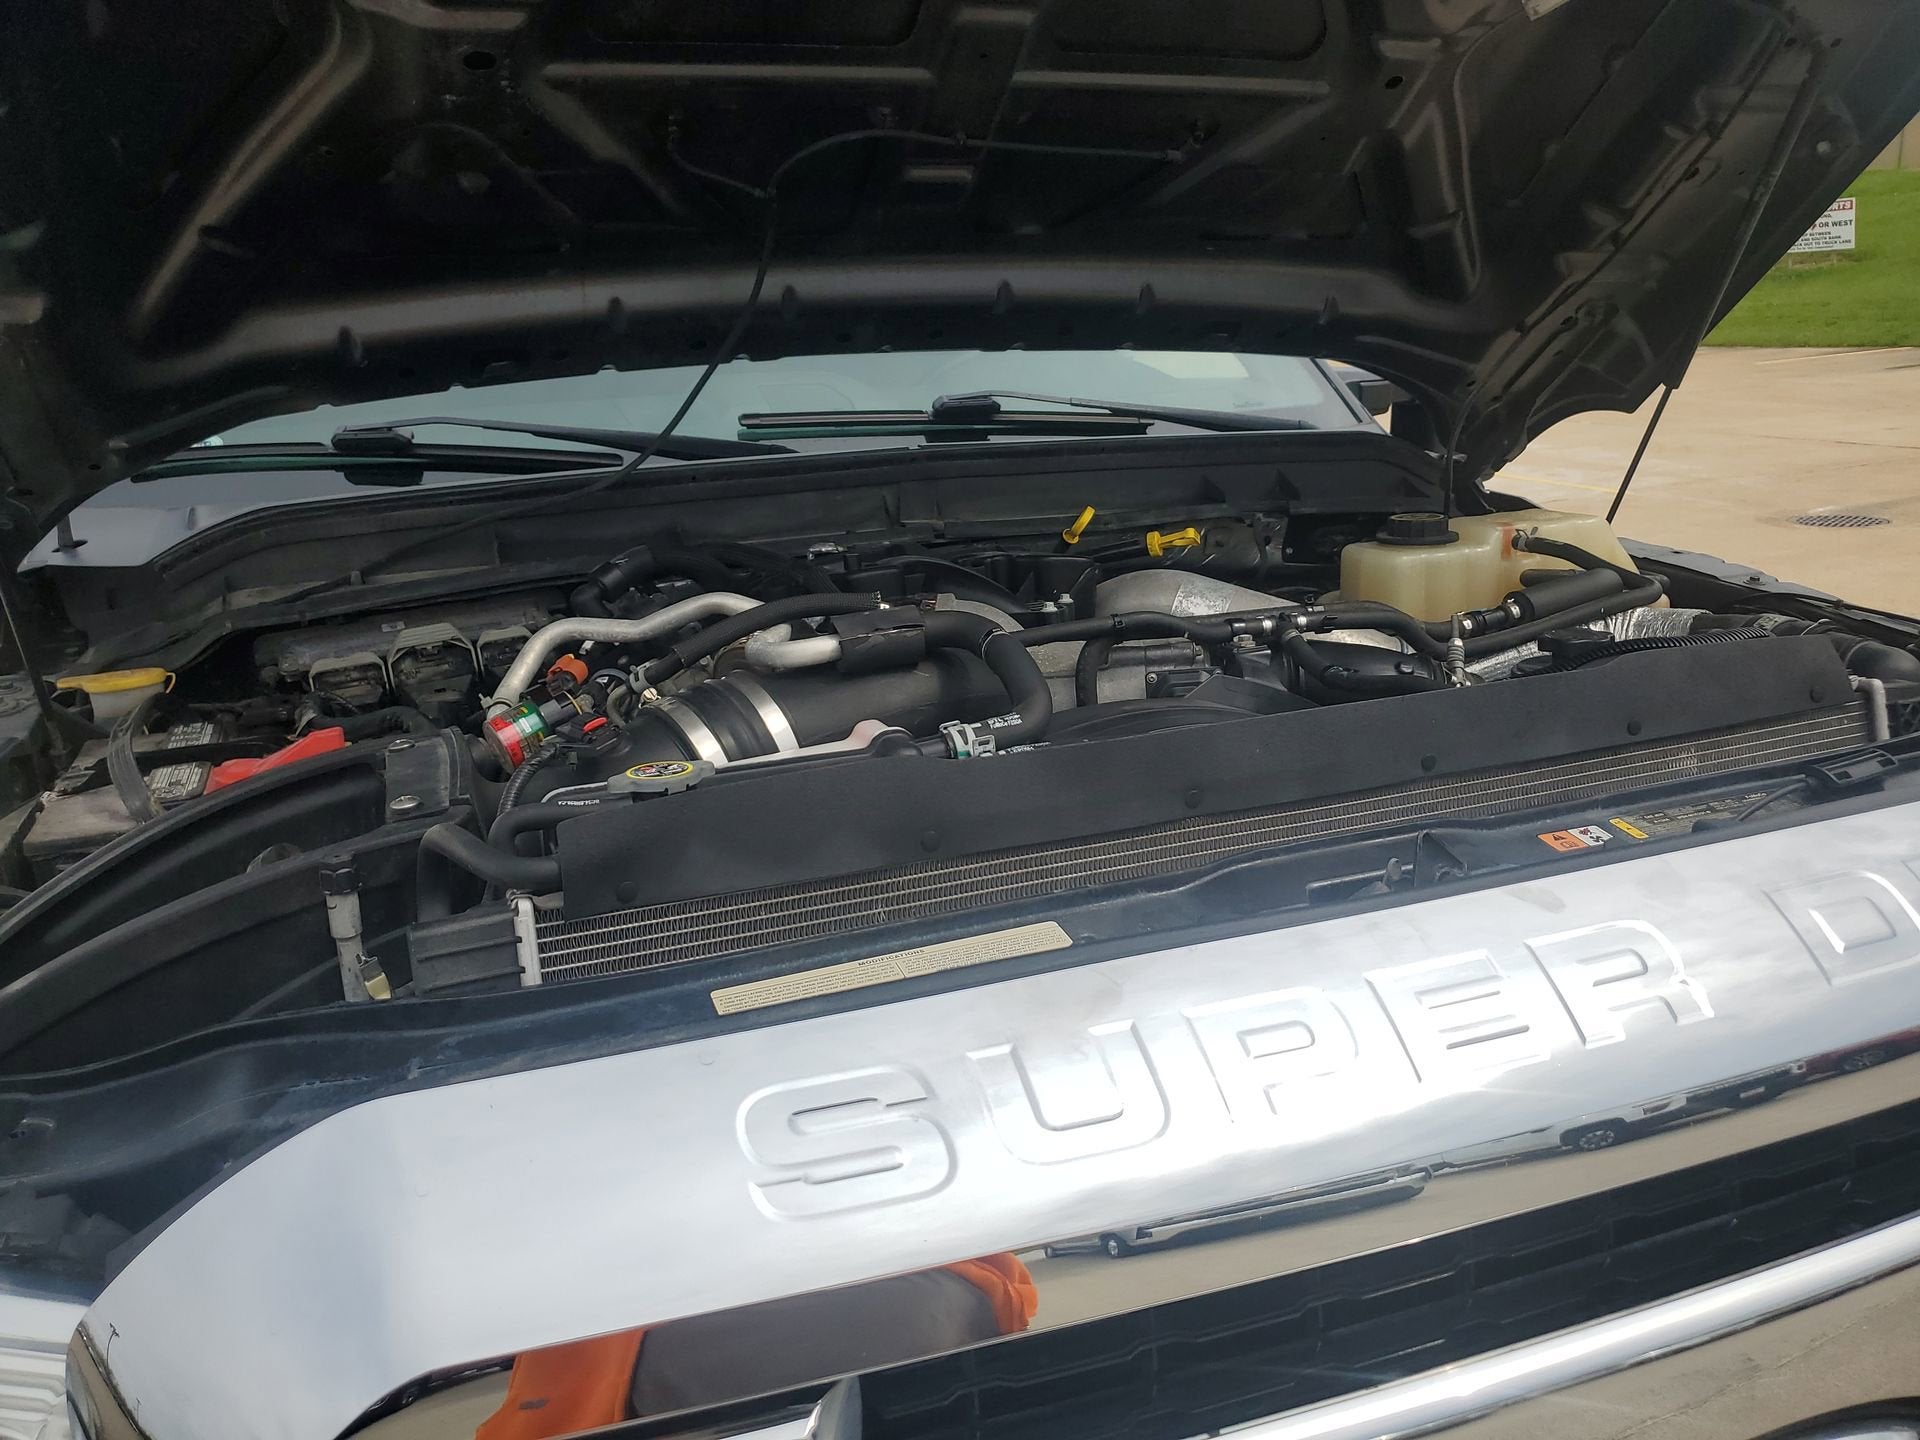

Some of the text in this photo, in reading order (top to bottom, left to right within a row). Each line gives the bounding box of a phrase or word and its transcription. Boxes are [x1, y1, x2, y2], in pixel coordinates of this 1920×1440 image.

[1831, 219, 1853, 227] WEST
[857, 949, 926, 967] MODIFICATIONS
[735, 918, 1713, 1222] SUPER
